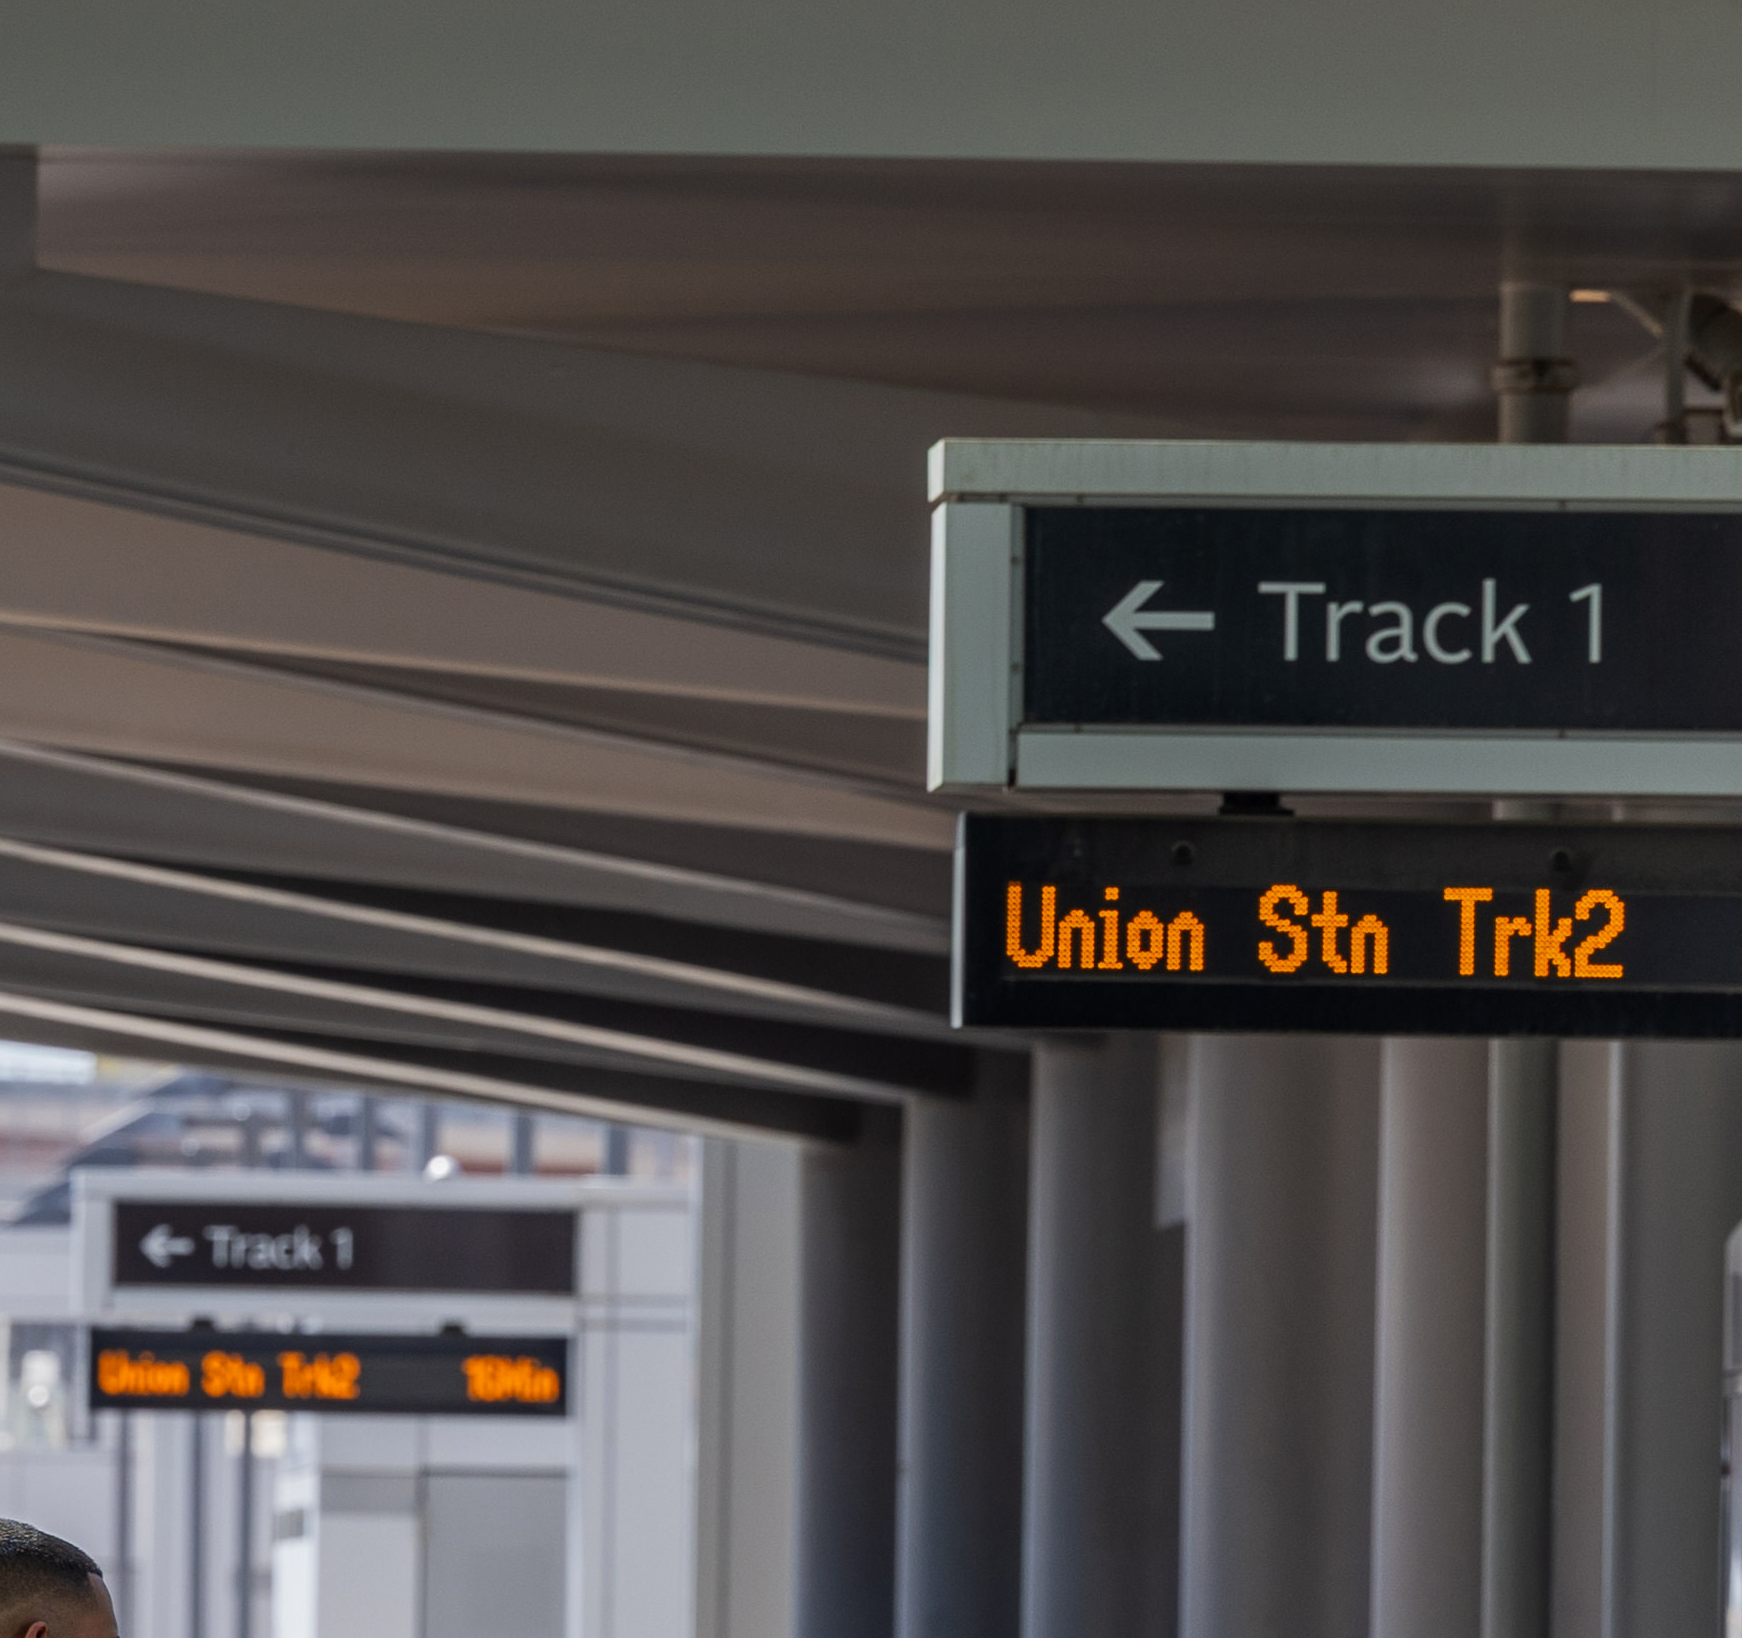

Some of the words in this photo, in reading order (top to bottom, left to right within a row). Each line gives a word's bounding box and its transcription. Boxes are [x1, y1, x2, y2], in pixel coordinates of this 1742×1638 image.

[1258, 577, 1532, 664] Track
[1570, 582, 1603, 664] 1
[1005, 881, 1206, 971] Union
[1257, 883, 1389, 975] Stn
[1443, 886, 1626, 979] Trk2
[206, 1224, 322, 1270] Track
[331, 1227, 354, 1268] 1
[98, 1350, 191, 1396] Union
[200, 1350, 266, 1398] Stn
[278, 1351, 362, 1401] Trk2
